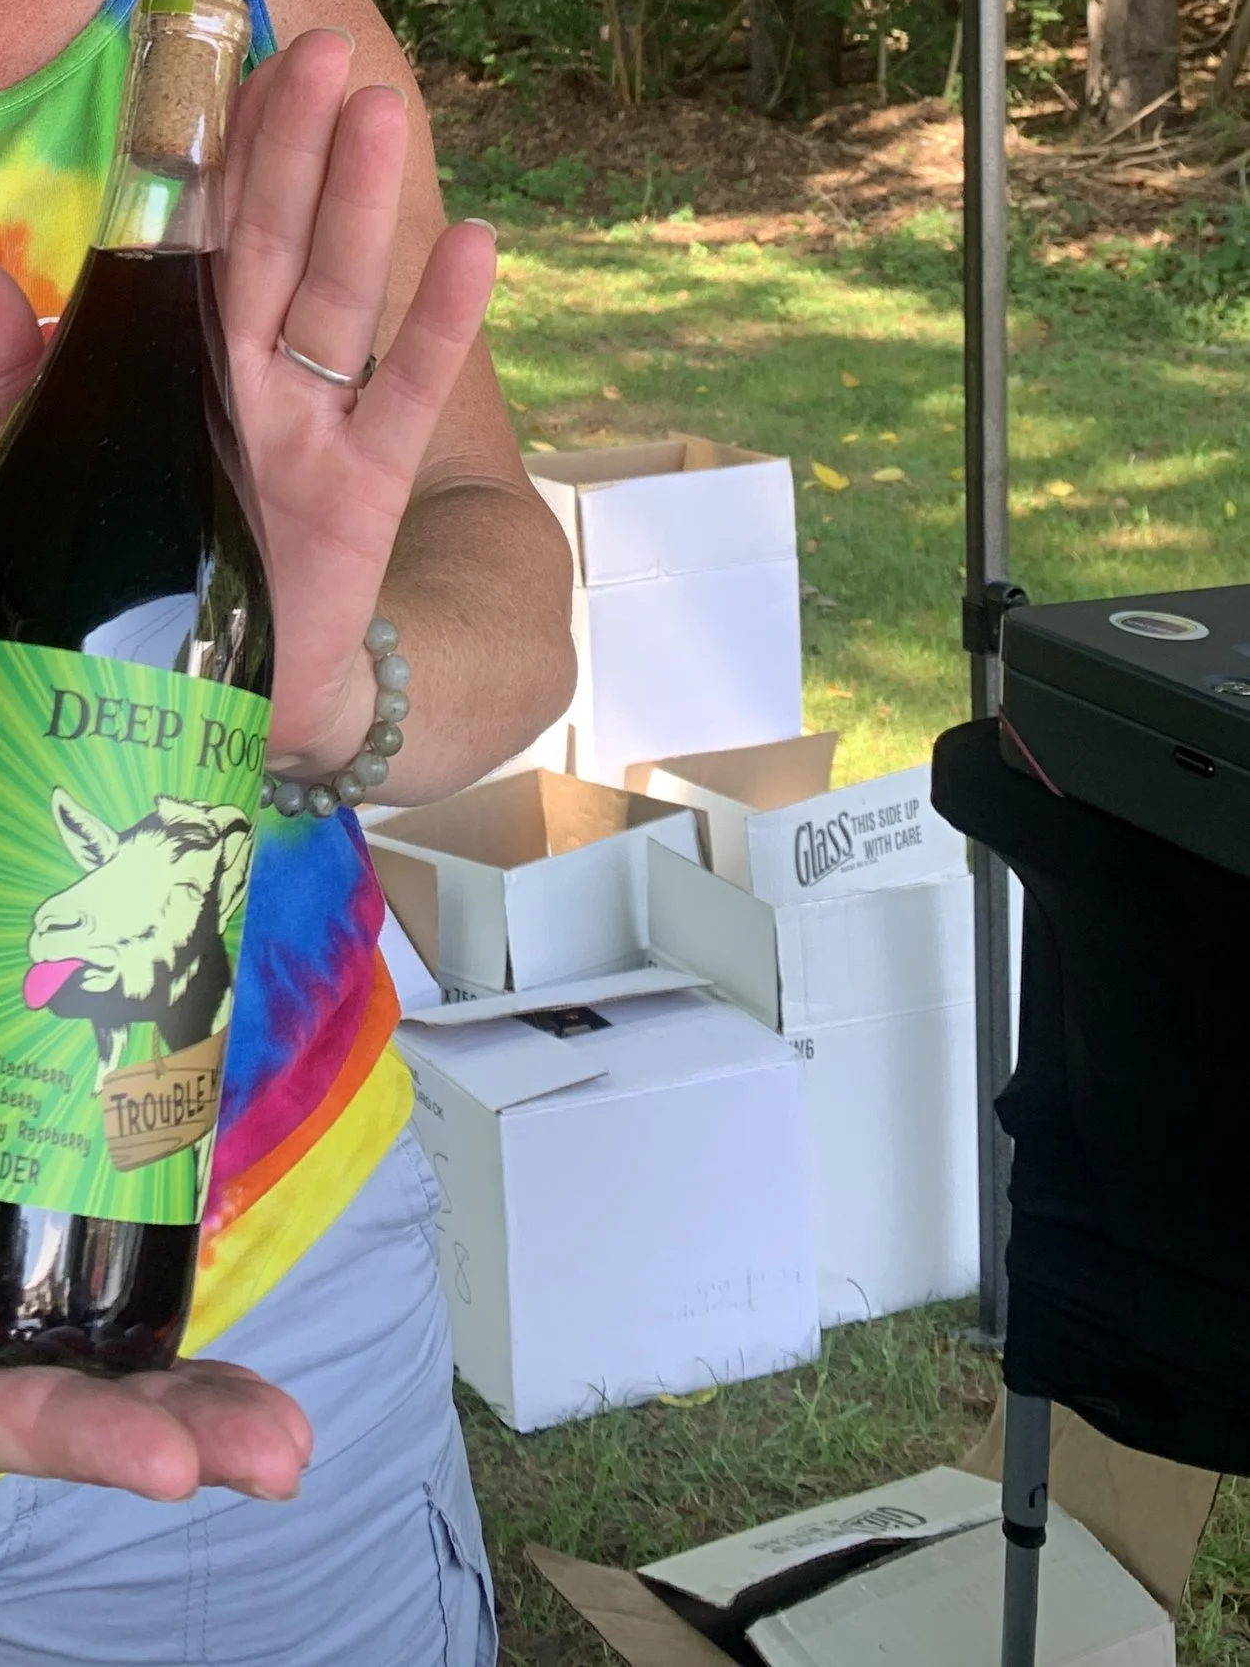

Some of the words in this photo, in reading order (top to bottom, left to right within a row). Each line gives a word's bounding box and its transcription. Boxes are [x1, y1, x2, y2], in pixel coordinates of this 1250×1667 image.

[43, 685, 183, 751] DEEP
[795, 811, 855, 887] Glass
[851, 813, 876, 836] THIS
[878, 804, 902, 828] SIDE
[905, 799, 919, 820] UP
[863, 835, 892, 859] WITH
[895, 825, 922, 850] CARE
[111, 1074, 205, 1138] TROUBLE
